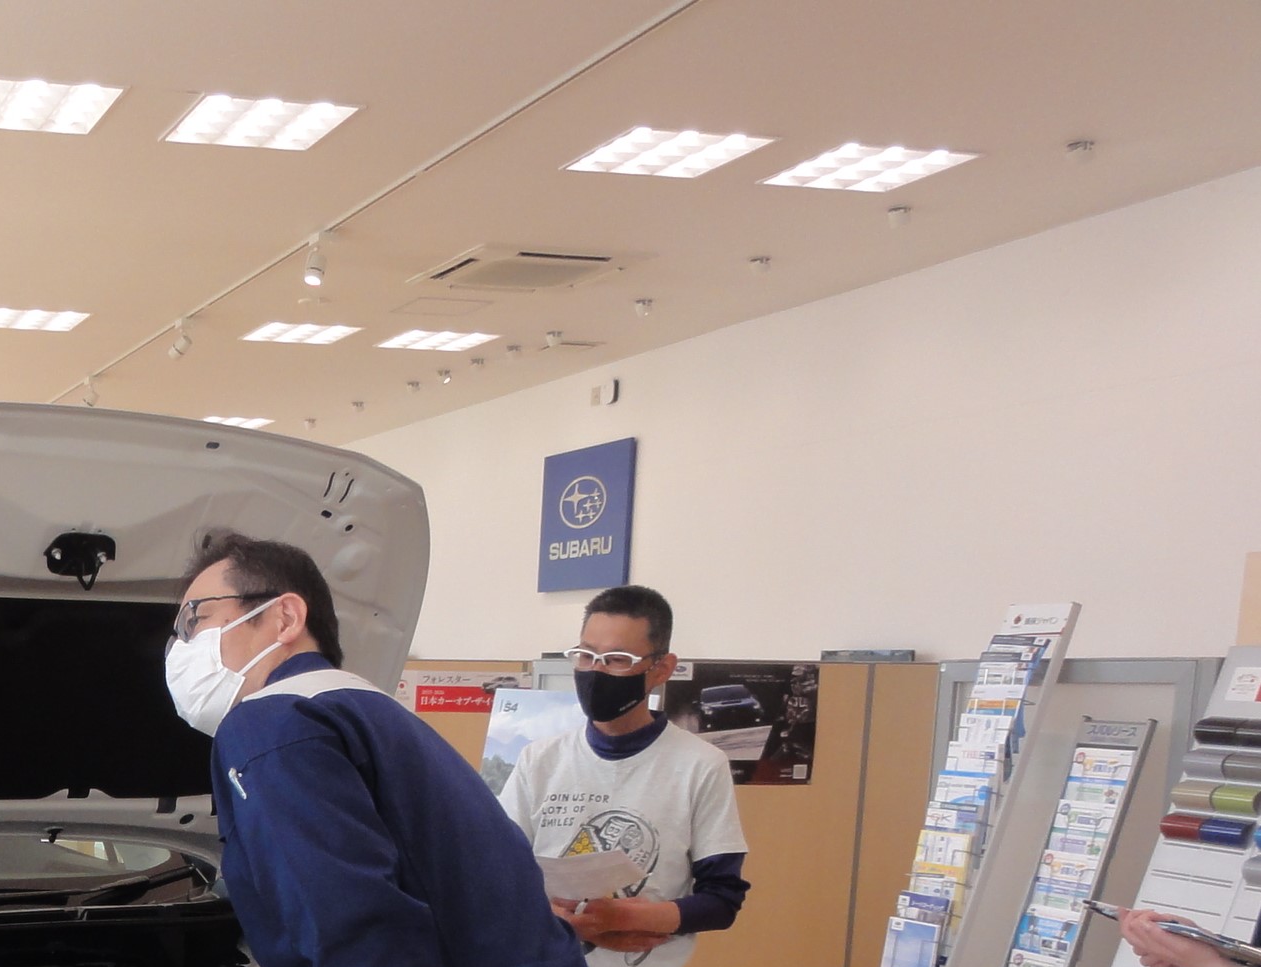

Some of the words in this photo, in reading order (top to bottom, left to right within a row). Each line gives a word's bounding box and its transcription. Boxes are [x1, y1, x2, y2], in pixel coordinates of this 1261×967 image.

[549, 536, 613, 560] SUBARU
[423, 675, 471, 685] フォレスター
[572, 793, 585, 801] US
[588, 793, 609, 803] FOR
[541, 806, 567, 814] LOTS
[573, 805, 585, 813] OF
[541, 817, 574, 827] SMILES
